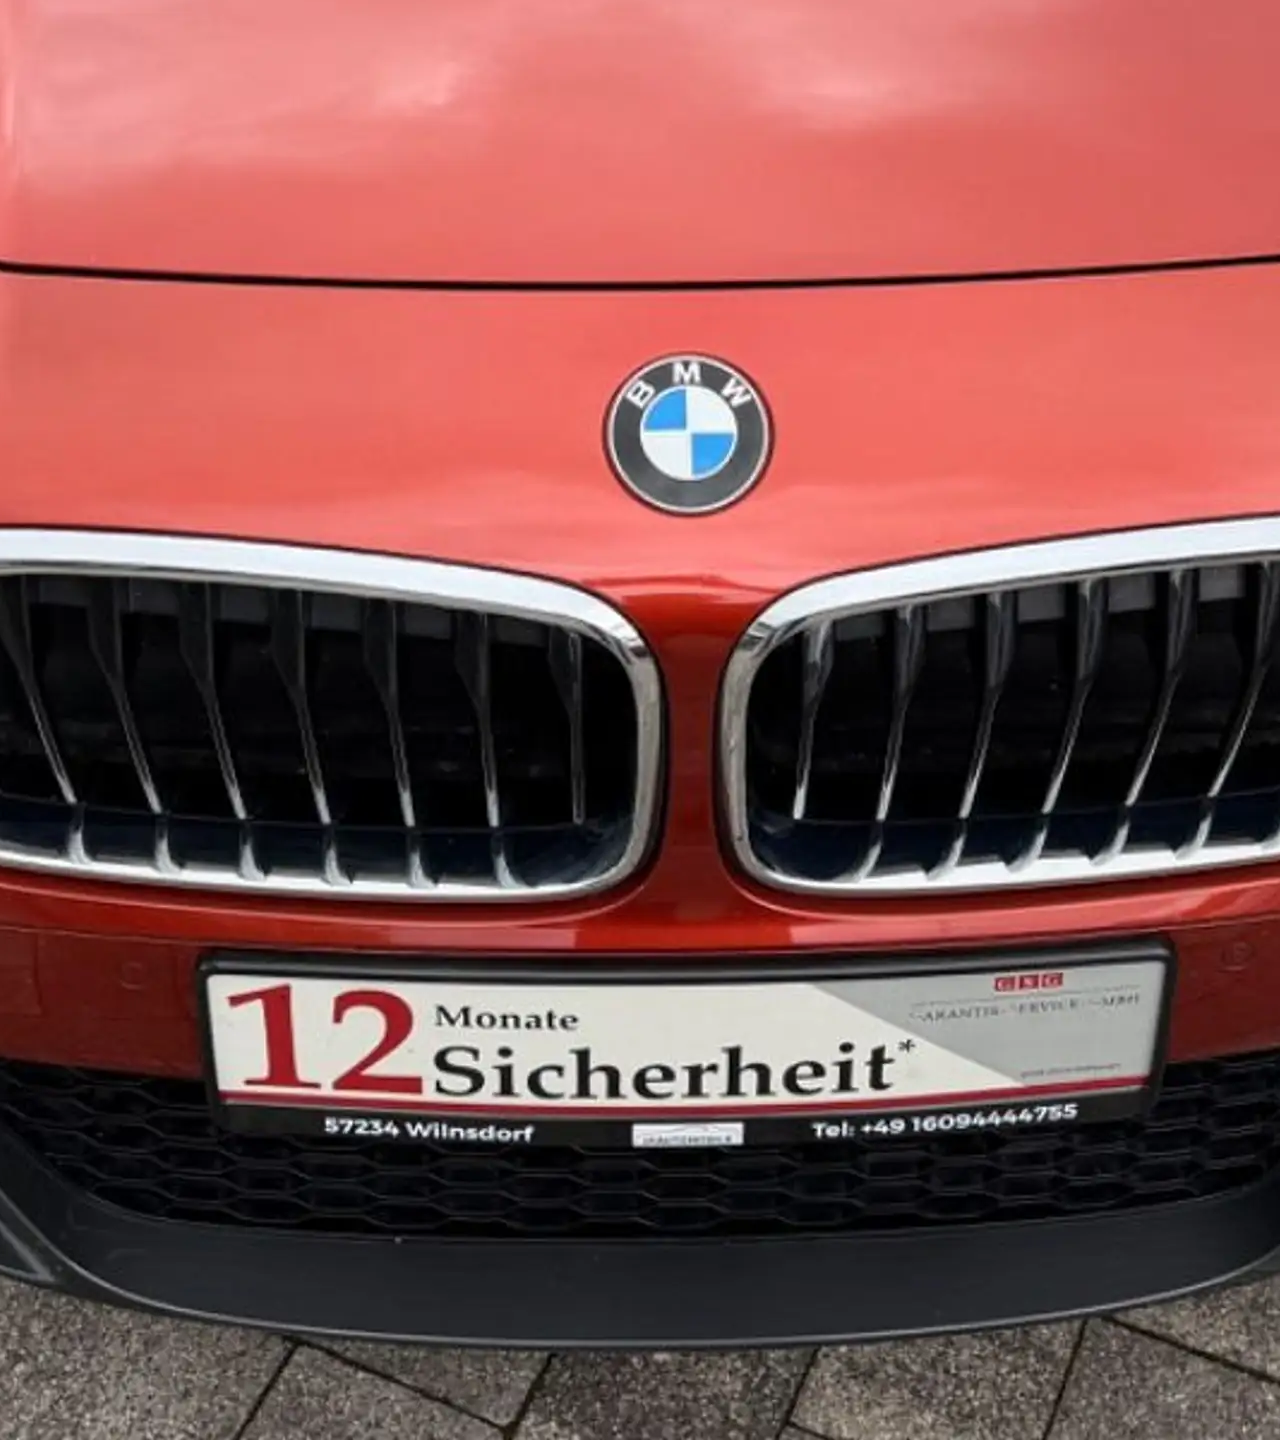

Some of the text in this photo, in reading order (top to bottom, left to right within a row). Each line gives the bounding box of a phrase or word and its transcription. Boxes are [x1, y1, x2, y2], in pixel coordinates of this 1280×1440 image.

[626, 361, 752, 408] BMW
[434, 1005, 579, 1031] Monate
[228, 983, 424, 1095] 12
[324, 1117, 535, 1142] 57234 Wilnsdorf
[813, 1103, 1079, 1139] Tel: +49 16094444755
